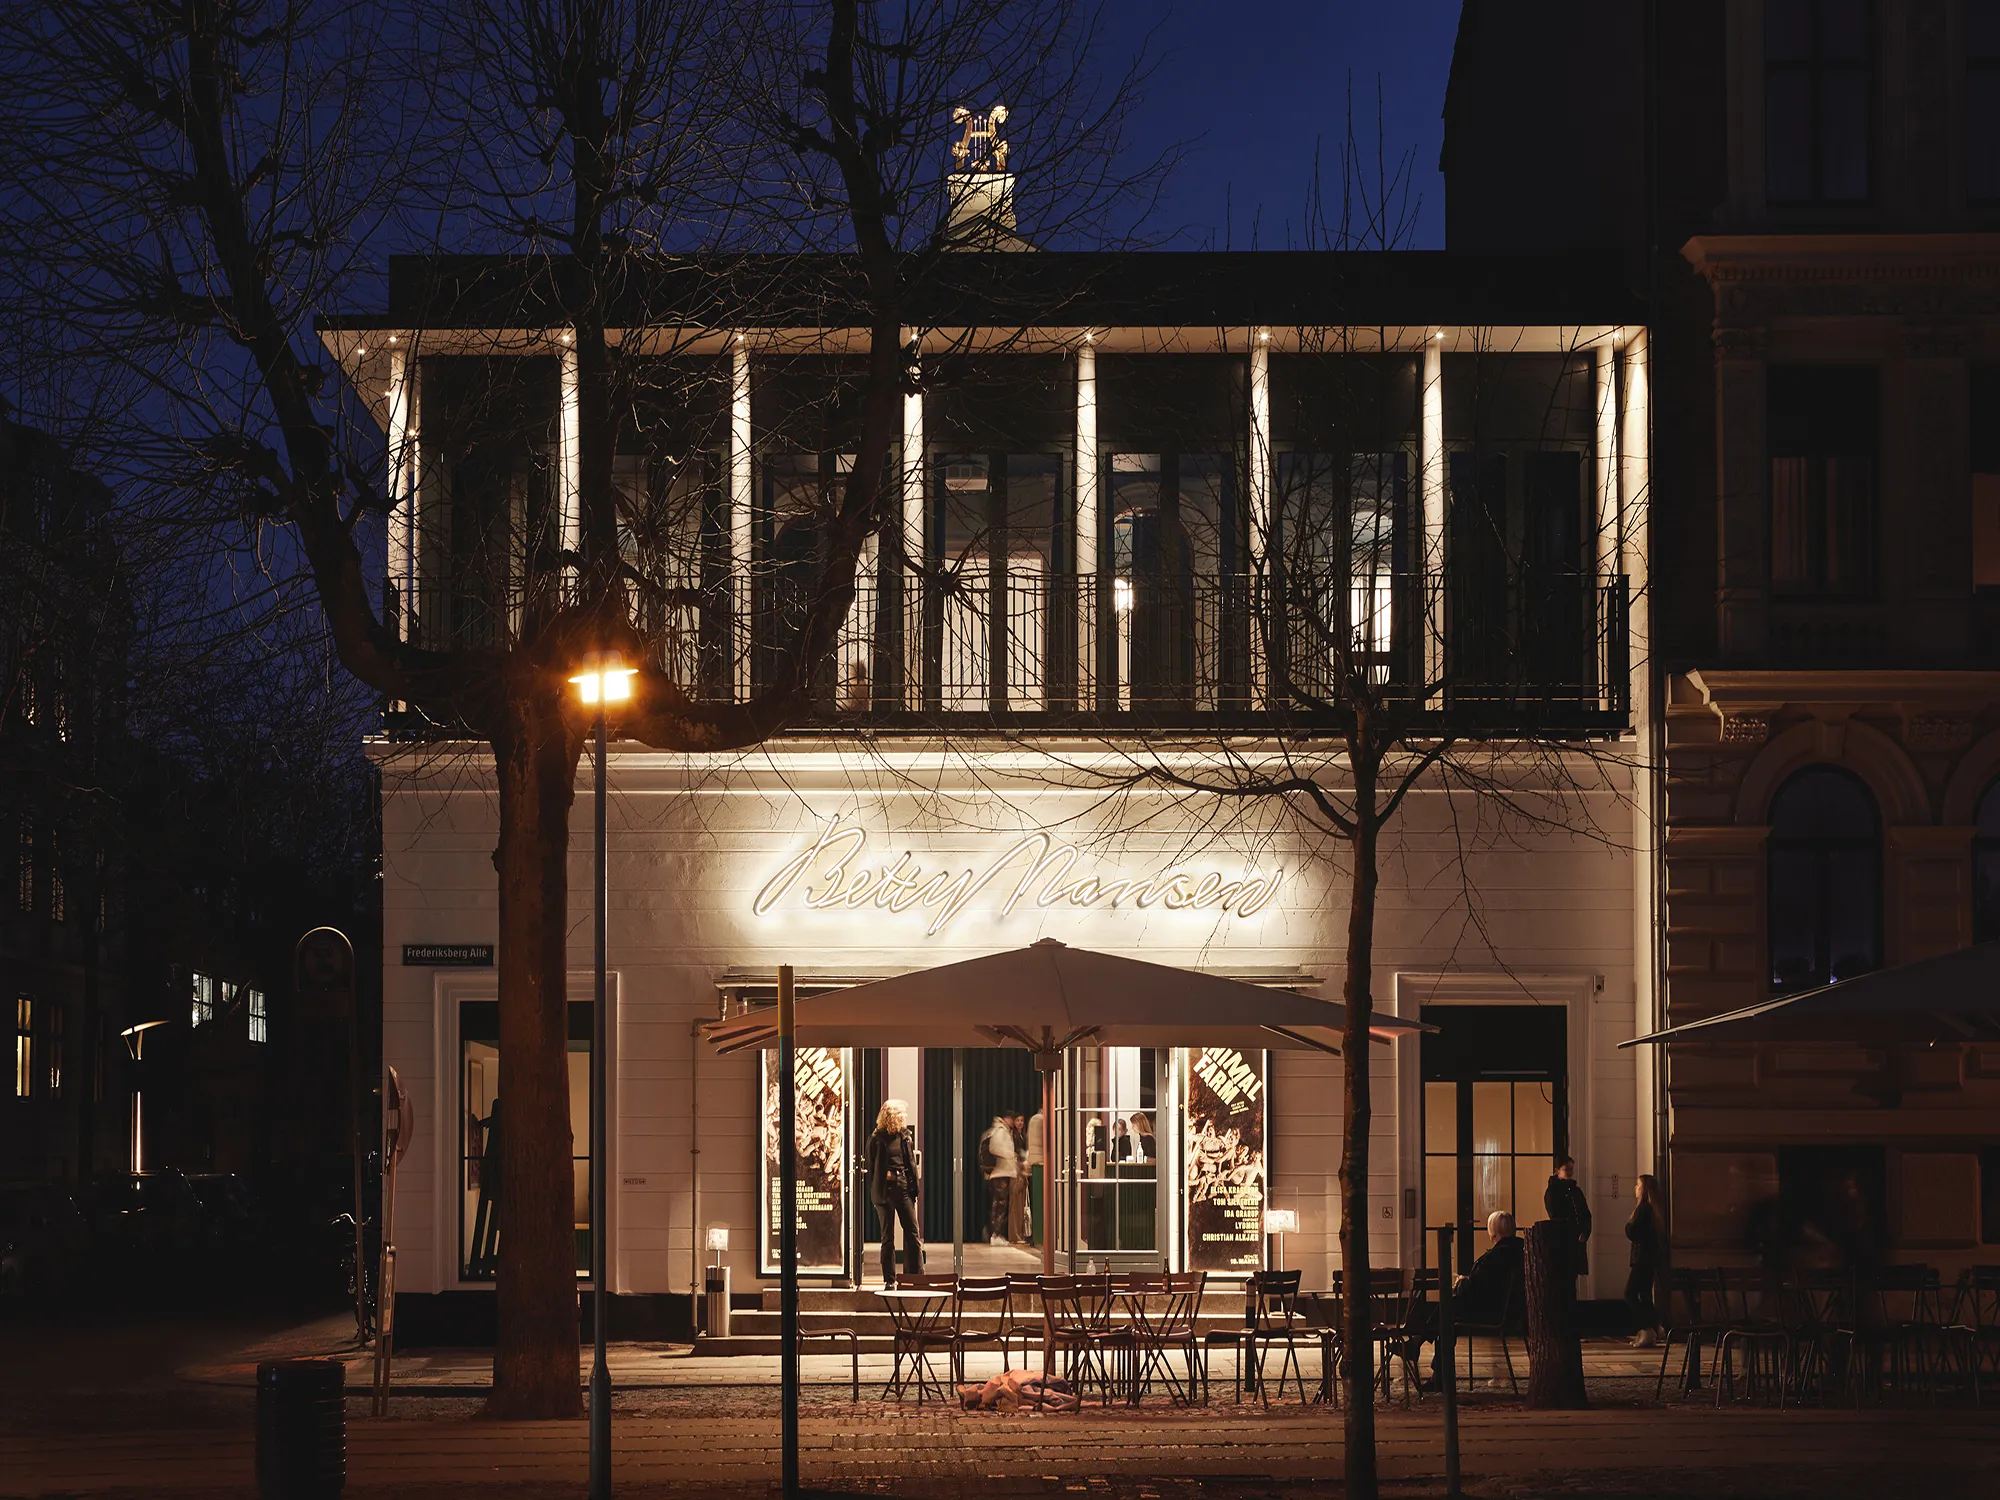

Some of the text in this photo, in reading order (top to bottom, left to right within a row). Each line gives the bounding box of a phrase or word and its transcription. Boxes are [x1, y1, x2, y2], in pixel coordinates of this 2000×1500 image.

[753, 813, 1284, 936] Betty Nansen
[407, 947, 487, 959] Frederiksberg Allé
[794, 1055, 826, 1100] ARM
[1193, 1054, 1240, 1105] FARM
[1213, 1198, 1226, 1206] TOM
[1224, 1210, 1235, 1218] IDA
[1202, 1233, 1234, 1241] CHRISTIAN
